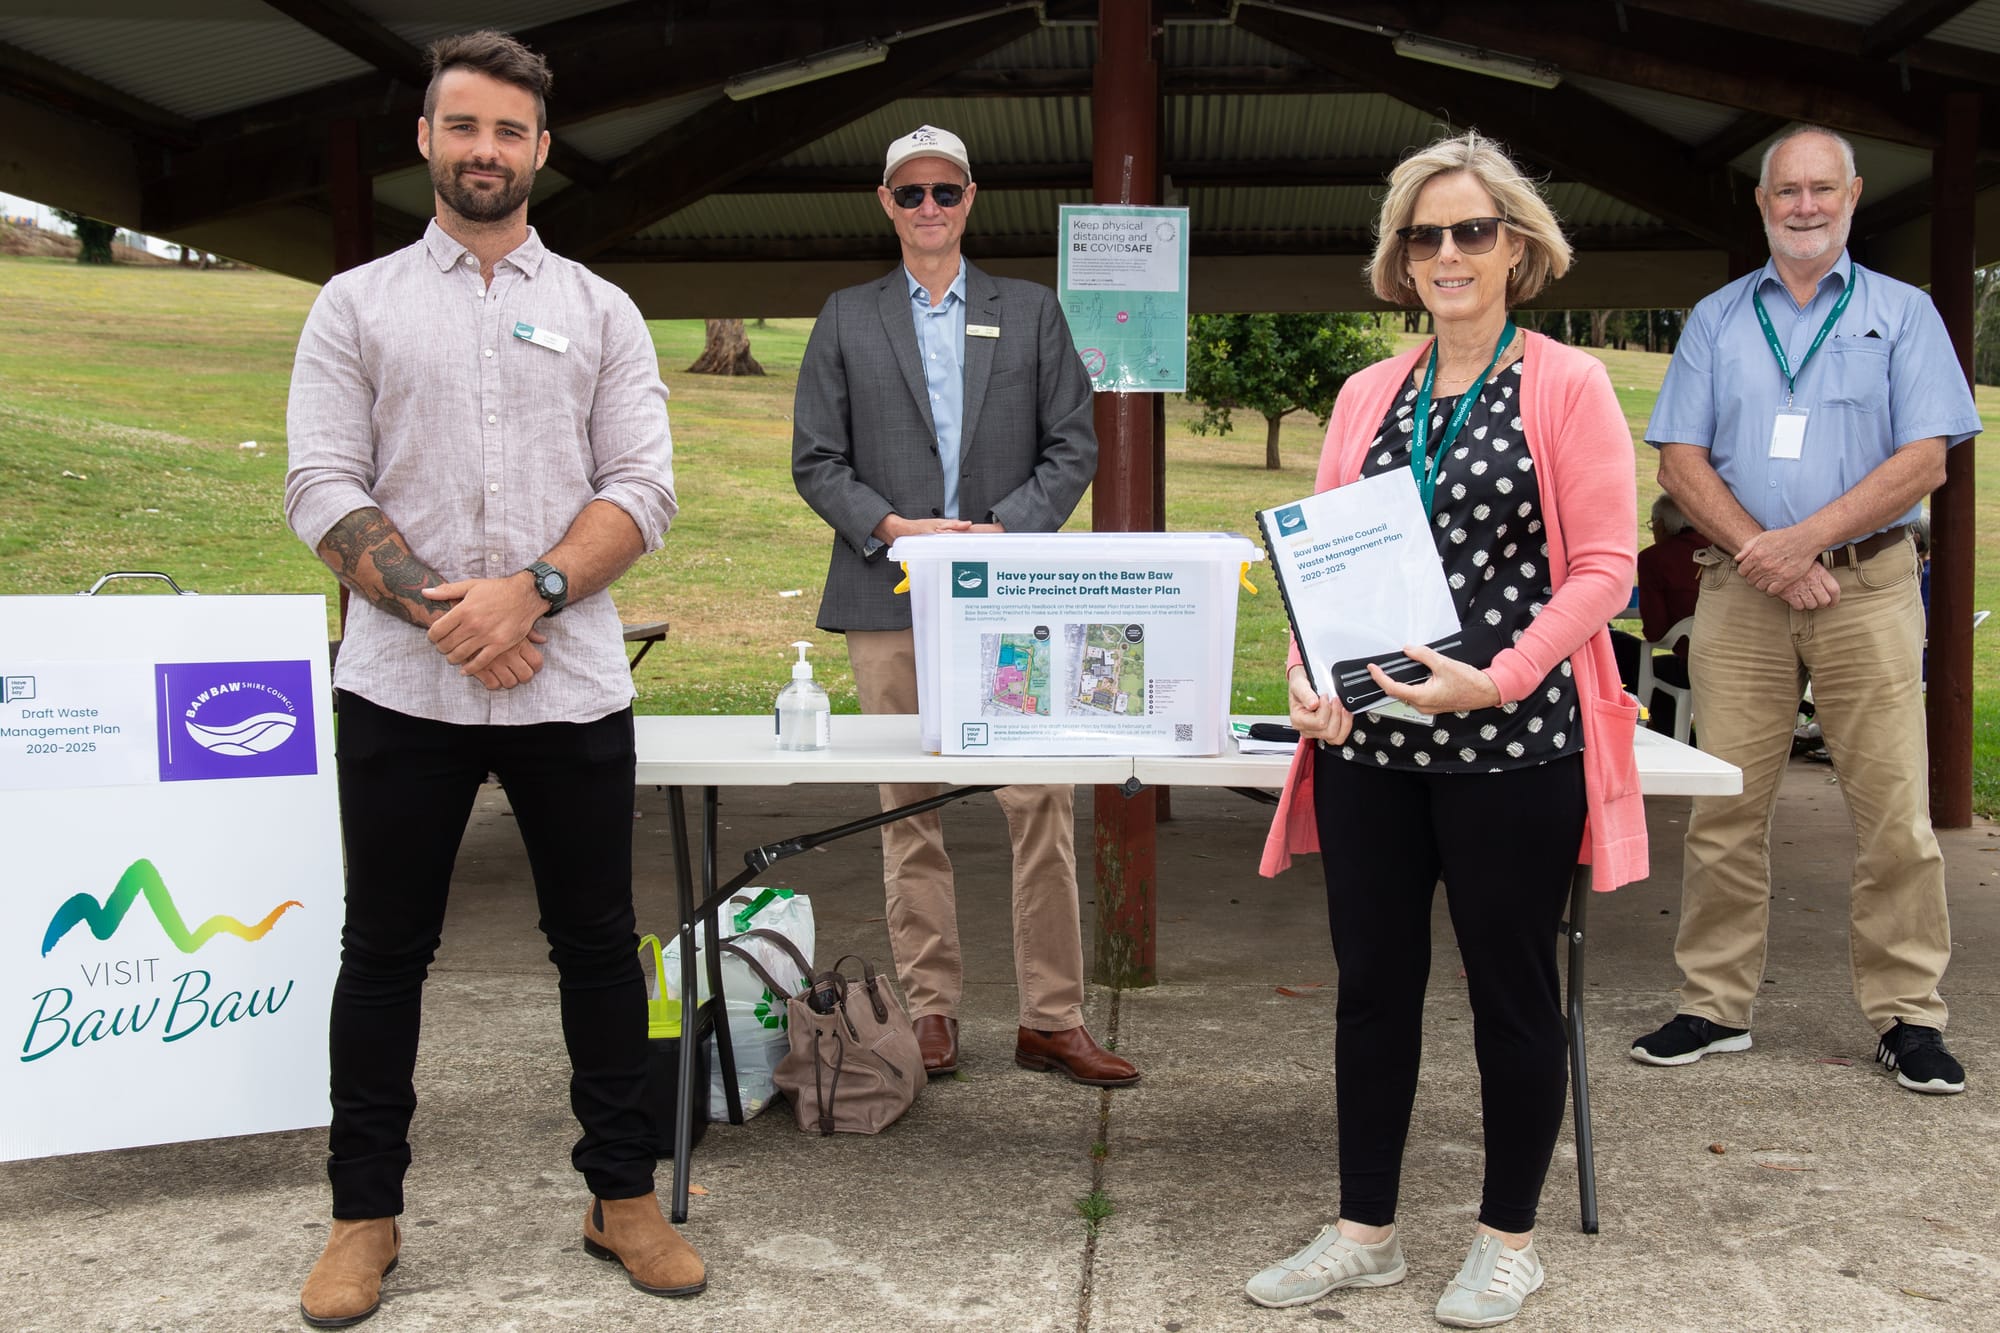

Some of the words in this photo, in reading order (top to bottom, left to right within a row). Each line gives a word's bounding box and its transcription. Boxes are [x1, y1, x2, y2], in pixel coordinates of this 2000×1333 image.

[1073, 220, 1100, 230] Keep
[1102, 220, 1143, 232] physical
[1073, 232, 1126, 242] distancing
[1128, 233, 1148, 242] and
[1073, 243, 1088, 252] BE
[1090, 244, 1153, 253] COVIDSAFE
[1452, 397, 1472, 428] Supportive
[1416, 418, 1425, 448] Optimistic
[1293, 546, 1312, 558] Baw
[1312, 542, 1332, 553] Baw
[1332, 534, 1354, 546] Shire
[1354, 522, 1388, 539] Council
[1296, 556, 1324, 570] Waste
[1325, 538, 1383, 562] Management
[1384, 532, 1404, 544] Plan
[996, 571, 1027, 580] Have
[1029, 572, 1056, 582] your
[1058, 572, 1078, 582] say
[1098, 571, 1118, 580] the
[1120, 571, 1146, 580] Baw
[1148, 571, 1174, 580] Baw
[1300, 562, 1346, 582] 2020-2025
[996, 585, 1026, 596] Civic
[1028, 585, 1076, 596] Precinct
[1079, 586, 1110, 596] Draft
[1112, 586, 1152, 596] Master
[1155, 586, 1181, 595] Plan
[186, 692, 210, 718] BAW
[210, 682, 241, 697] BAW
[242, 682, 266, 691] SHIRE
[266, 686, 295, 712] COUNCIL
[22, 708, 54, 719] Draft
[58, 708, 98, 718] Waste
[0, 726, 90, 738] Management
[93, 724, 120, 734] Plan
[26, 742, 96, 754] 2020-2025
[80, 958, 160, 987] VISIT
[20, 987, 160, 1062] Baw
[162, 970, 294, 1042] Baw
